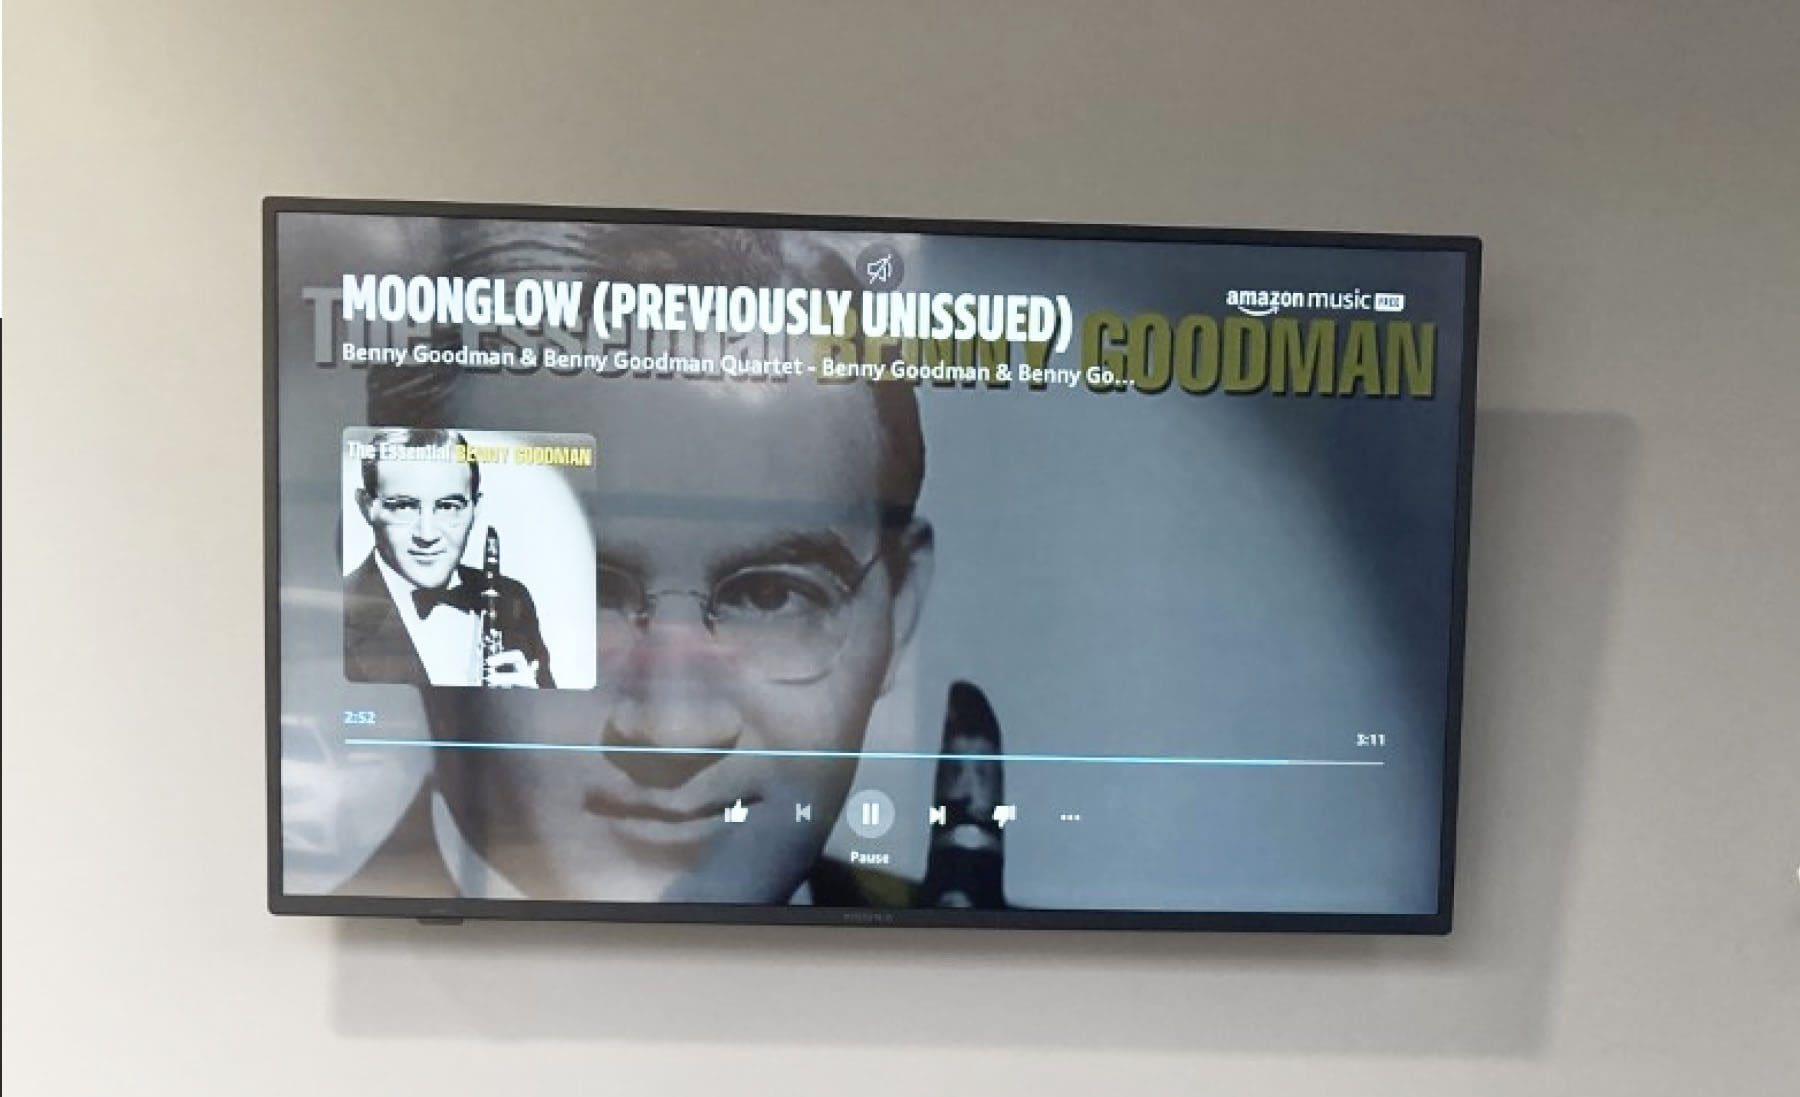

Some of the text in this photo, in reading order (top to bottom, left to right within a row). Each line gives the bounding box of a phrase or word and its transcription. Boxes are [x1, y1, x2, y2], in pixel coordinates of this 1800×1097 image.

[1226, 290, 1304, 313] amazon
[1308, 288, 1372, 310] music
[342, 274, 1073, 353] MOONGLOW (PREVIOUSLY UNISSUED)
[343, 344, 408, 367] Benny
[414, 345, 514, 366] Goodman
[520, 348, 537, 366] &
[545, 348, 608, 371] Benny
[614, 351, 714, 372] Goodman
[722, 354, 803, 377] Quartet
[823, 358, 886, 381] Benny
[891, 360, 990, 380] Goodman
[996, 364, 1013, 381] &
[1019, 364, 1081, 387] Benny
[1082, 309, 1437, 398] GOODMAN
[343, 710, 377, 724] 2:52
[1356, 733, 1386, 747] 3:11
[850, 851, 889, 864] Pause
